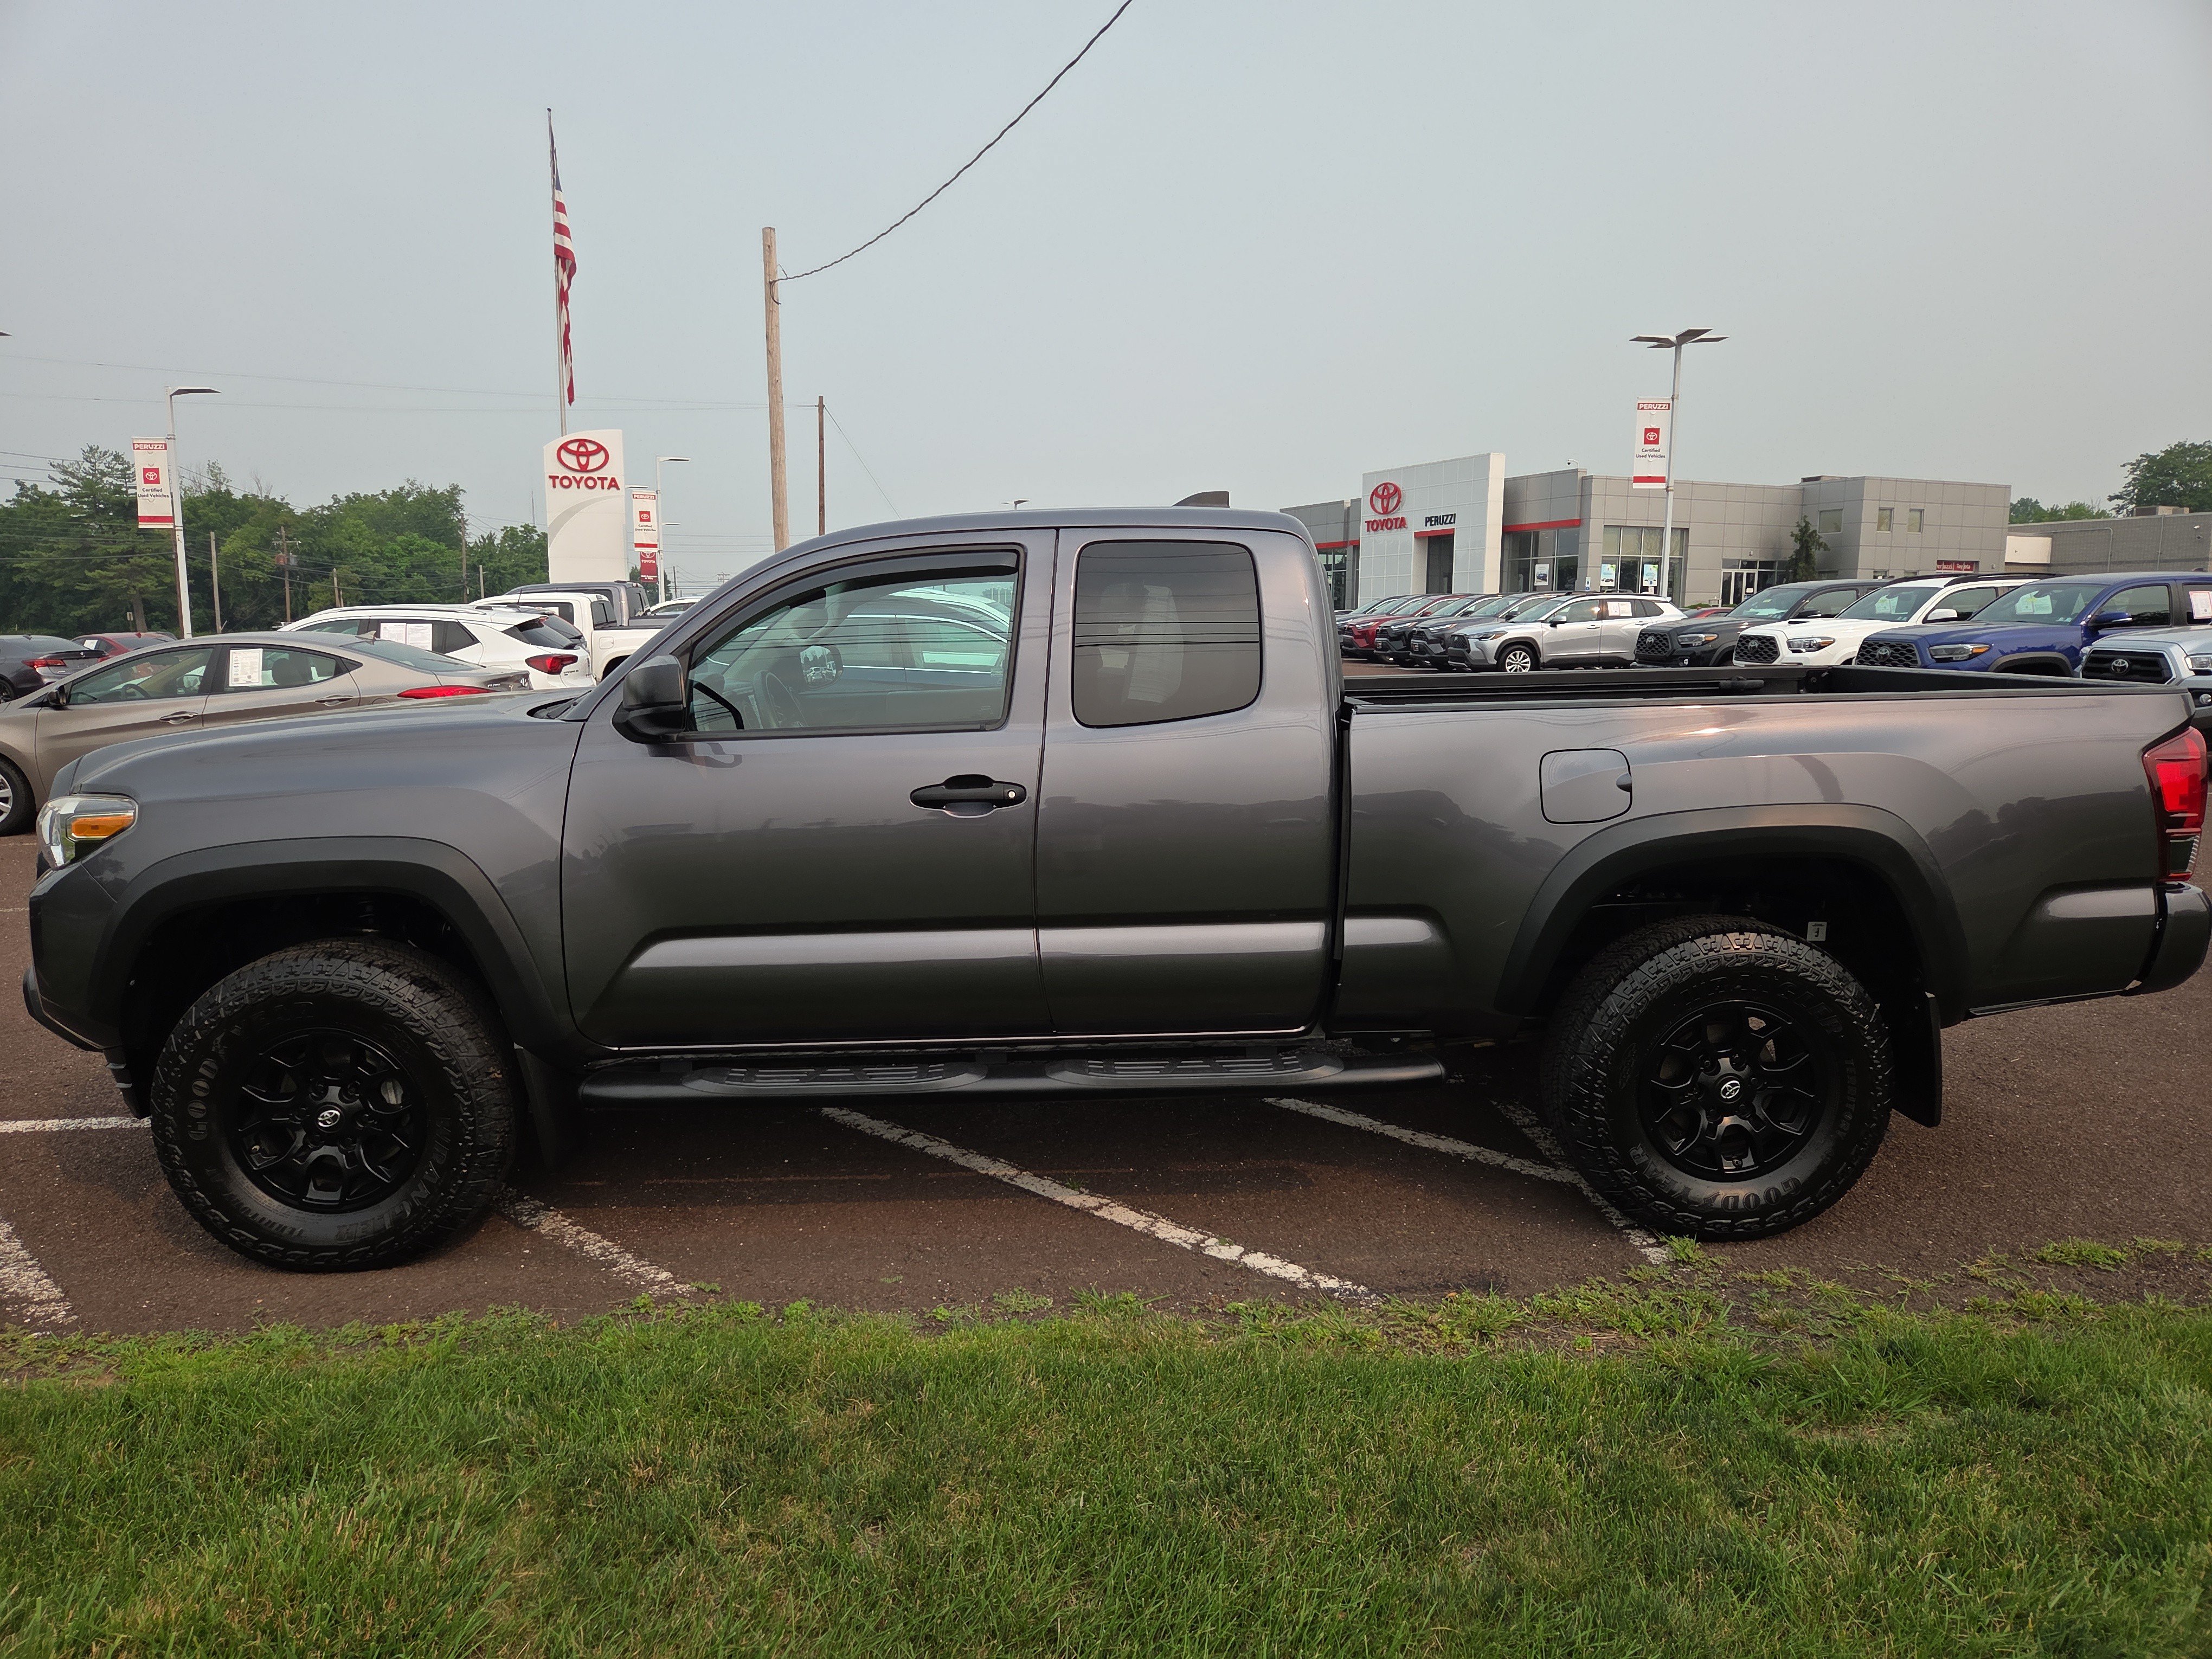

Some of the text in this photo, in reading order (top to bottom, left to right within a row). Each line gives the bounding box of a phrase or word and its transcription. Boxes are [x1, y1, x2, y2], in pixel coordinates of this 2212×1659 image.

[549, 475, 620, 490] TOYOTA
[1365, 517, 1407, 532] TOYOTA
[1425, 513, 1456, 527] PERUZZI
